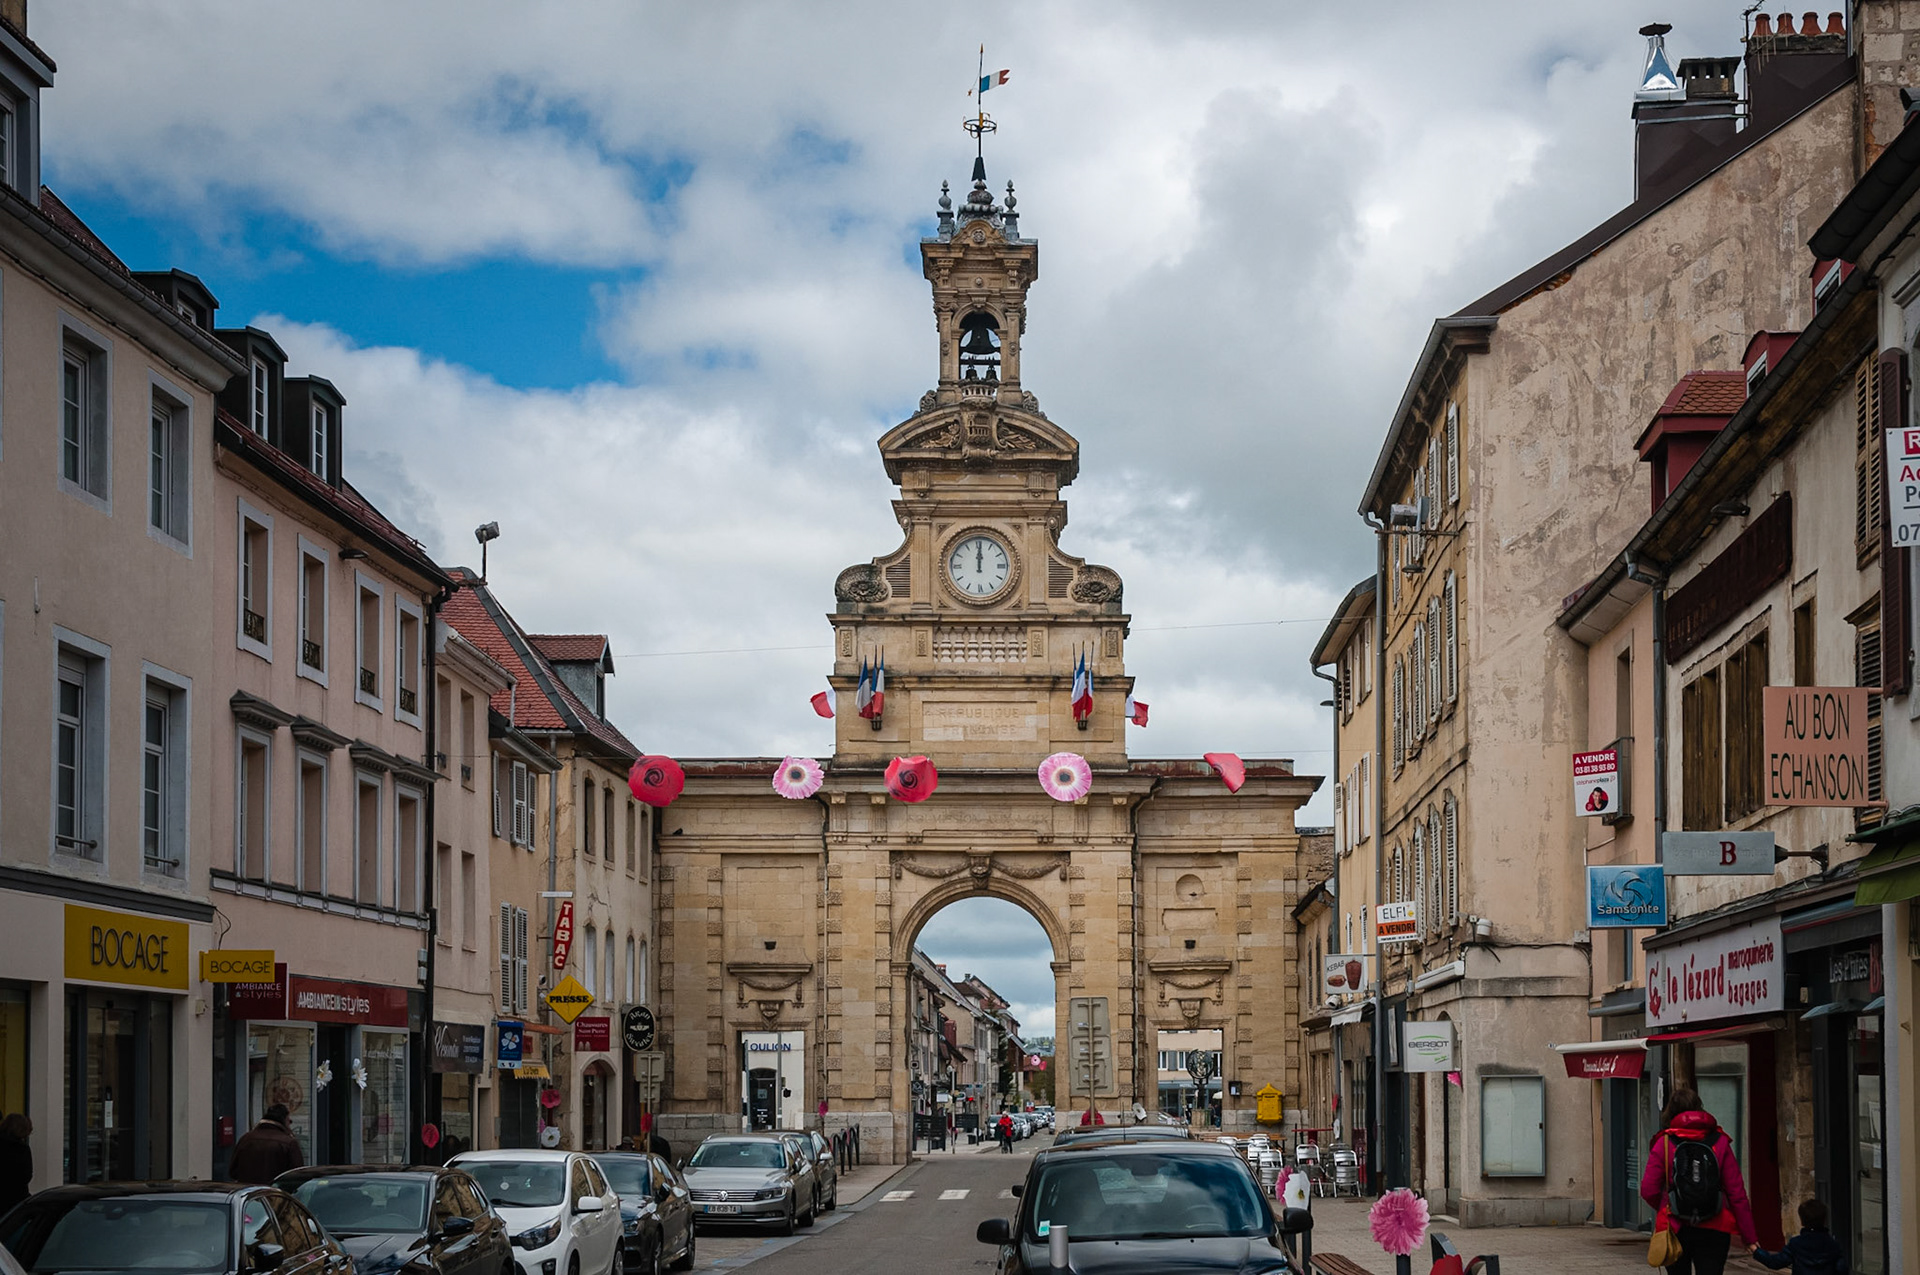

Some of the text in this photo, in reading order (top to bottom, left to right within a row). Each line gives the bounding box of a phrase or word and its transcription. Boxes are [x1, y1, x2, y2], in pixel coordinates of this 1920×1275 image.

[1784, 693, 1849, 740] AU BON
[1575, 752, 1615, 765] A VENDRE
[1771, 753, 1863, 801] ECHANSON
[1719, 841, 1737, 866] B
[1382, 906, 1406, 919] ELFI
[1597, 904, 1660, 915] Samsonite
[554, 903, 572, 967] TABAC
[1379, 927, 1385, 935] A
[91, 925, 169, 973] BOCAGE
[1728, 936, 1774, 970] maroquinerie
[210, 960, 271, 974] BOCAGE
[1327, 959, 1345, 972] KEBAB
[235, 982, 282, 990] AMBIANCE
[1667, 953, 1724, 1004] le lézard
[549, 995, 589, 1004] PRESSE
[1728, 979, 1768, 1006] bagages
[341, 994, 370, 1015] styles
